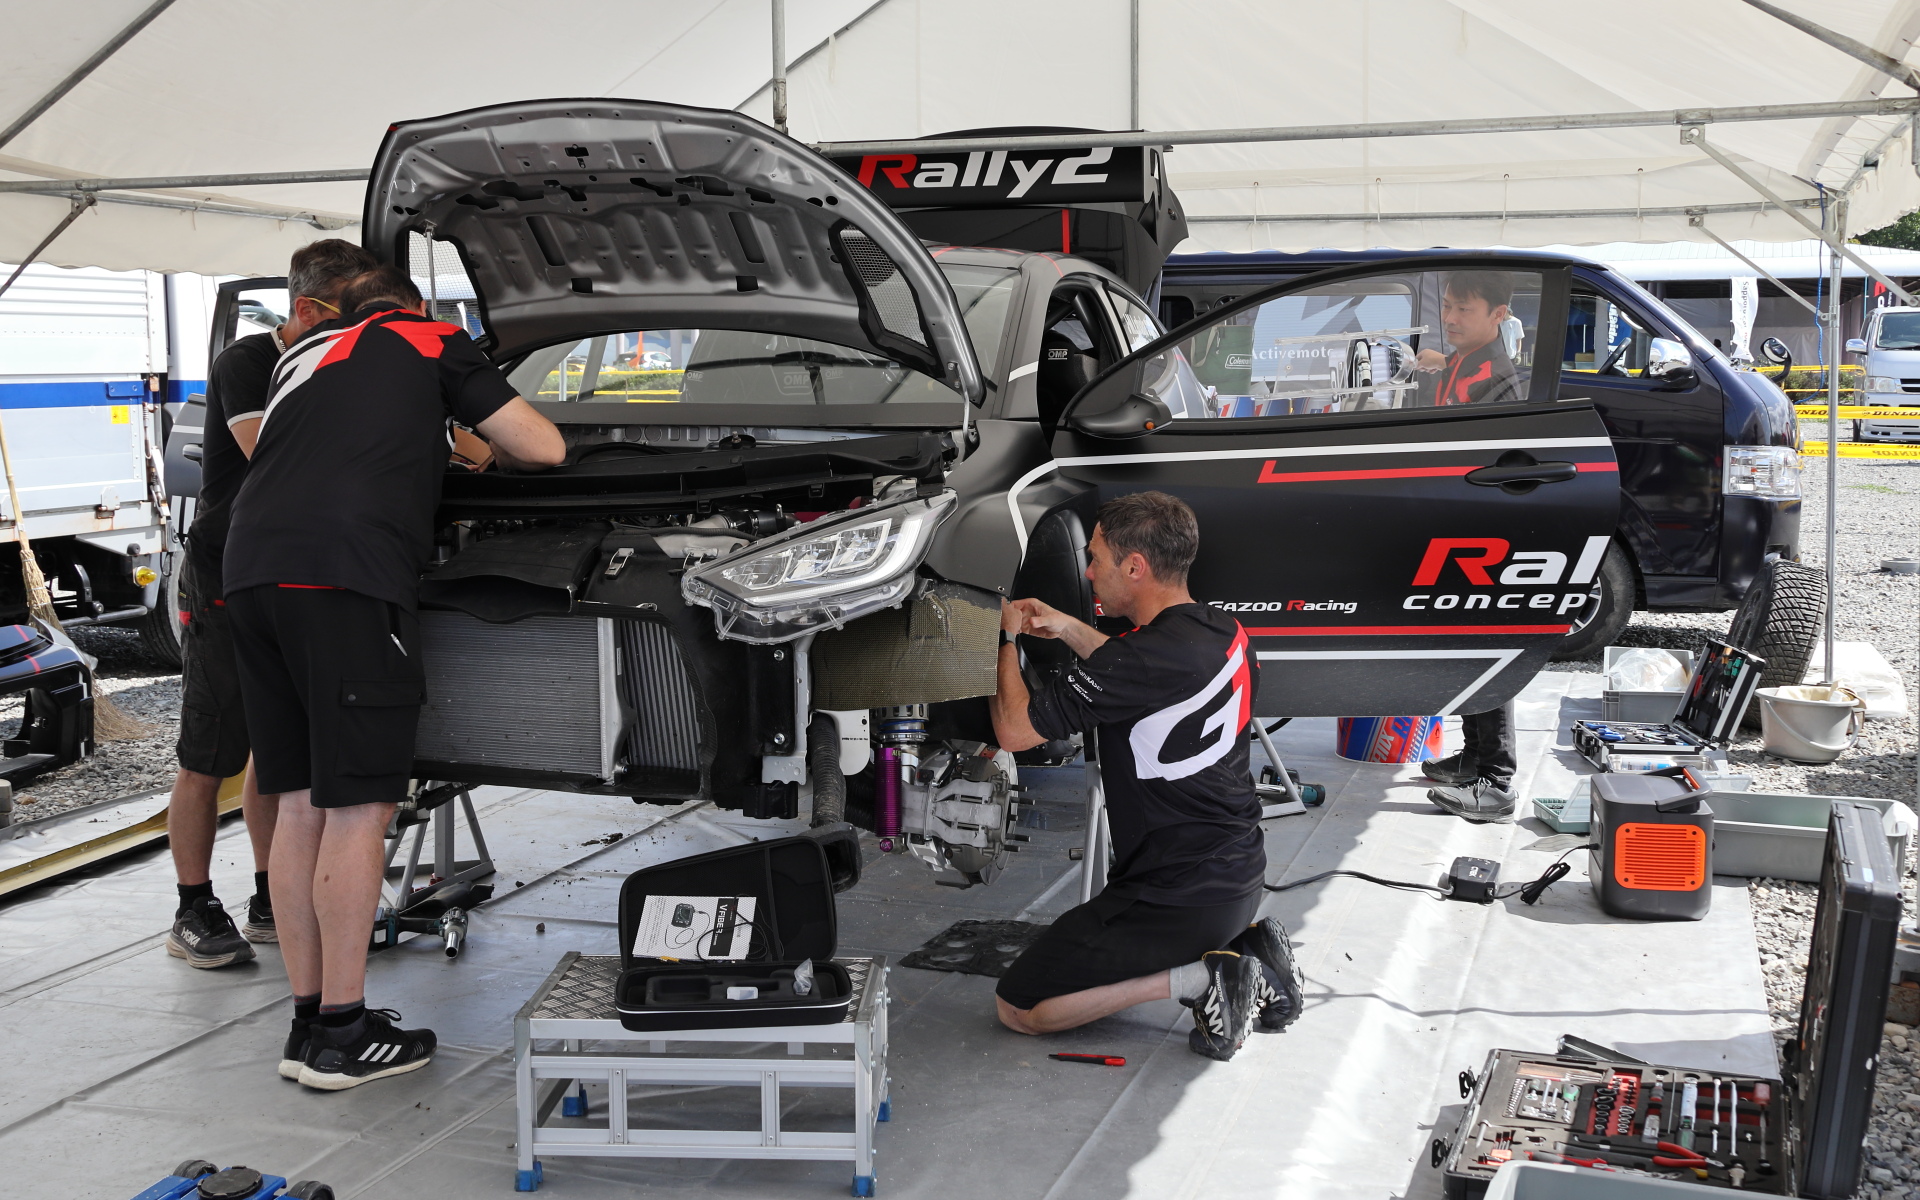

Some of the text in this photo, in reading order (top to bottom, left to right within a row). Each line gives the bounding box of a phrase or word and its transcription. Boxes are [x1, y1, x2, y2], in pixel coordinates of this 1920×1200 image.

[857, 147, 1113, 198] Rally2
[686, 371, 703, 379] OMP
[783, 374, 809, 385] OMP
[1411, 536, 1611, 586] Ral
[1286, 600, 1358, 614] Racing
[1403, 593, 1587, 615] concep
[181, 927, 201, 947] HOKA
